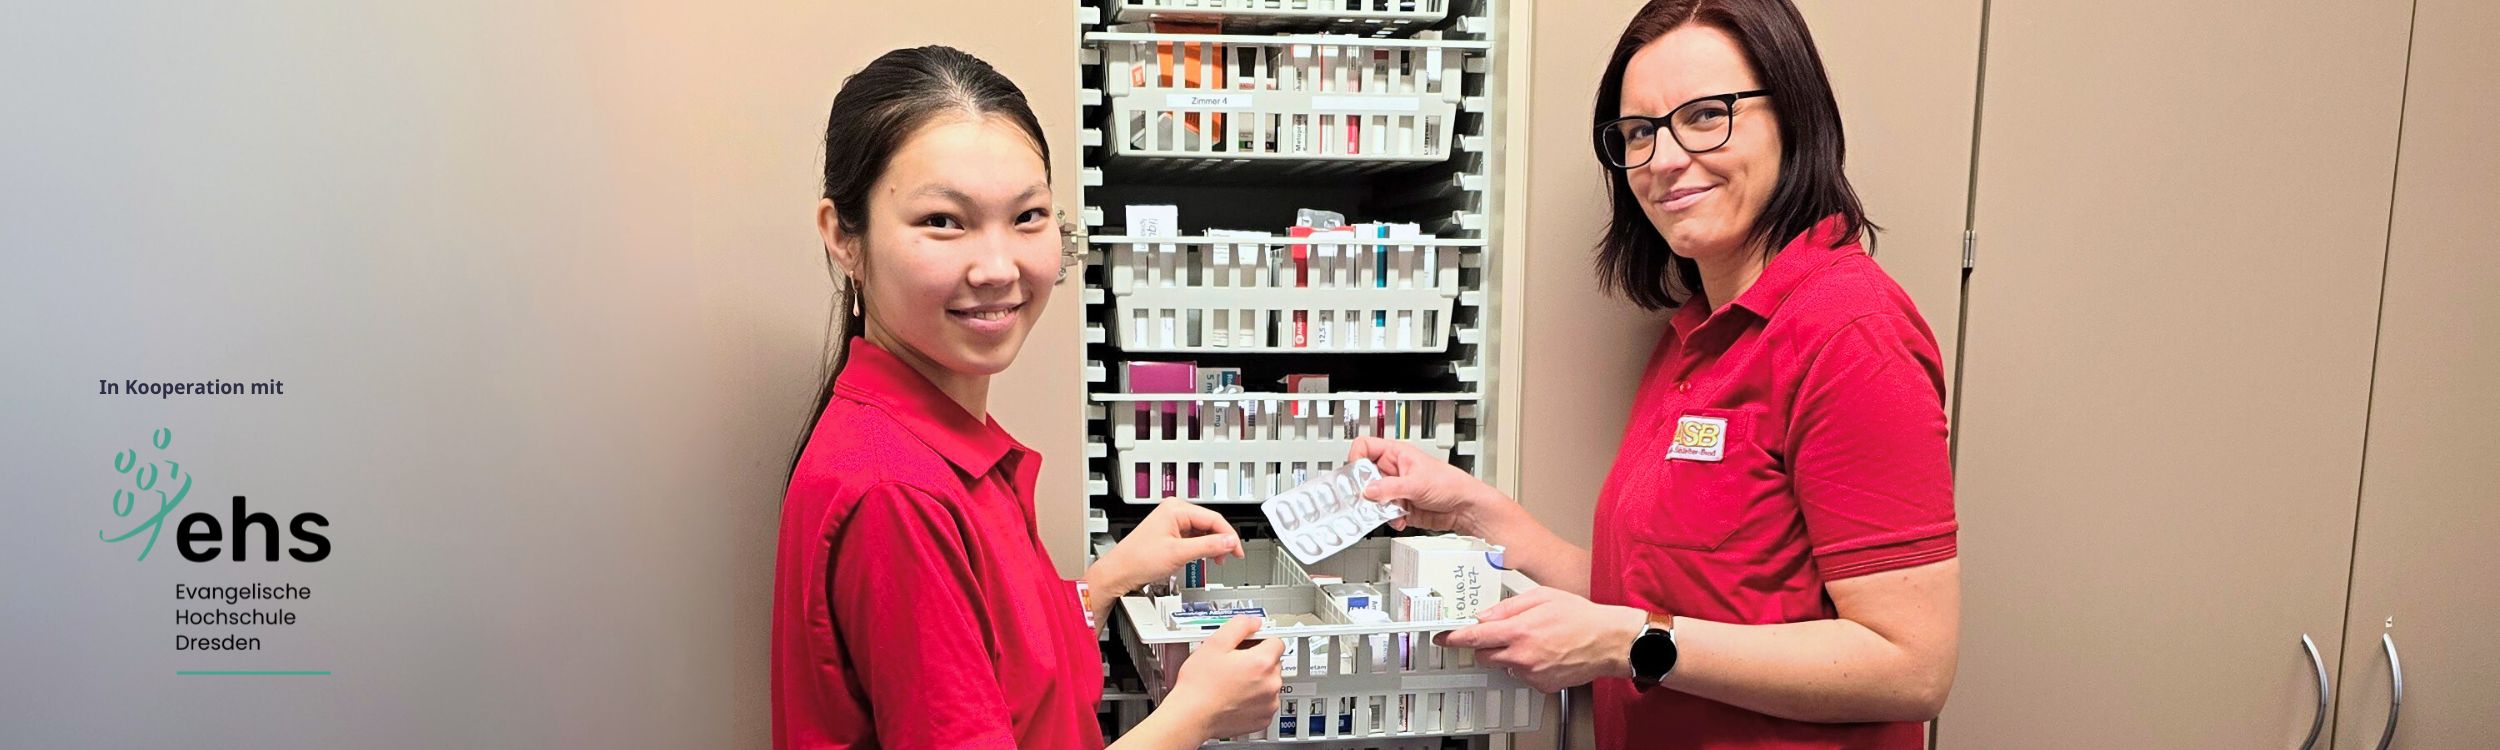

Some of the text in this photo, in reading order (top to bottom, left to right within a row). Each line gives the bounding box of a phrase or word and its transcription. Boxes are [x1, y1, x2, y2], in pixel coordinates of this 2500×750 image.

[1191, 96, 1228, 105] Zimmer 4
[1281, 721, 1296, 729] 1000
